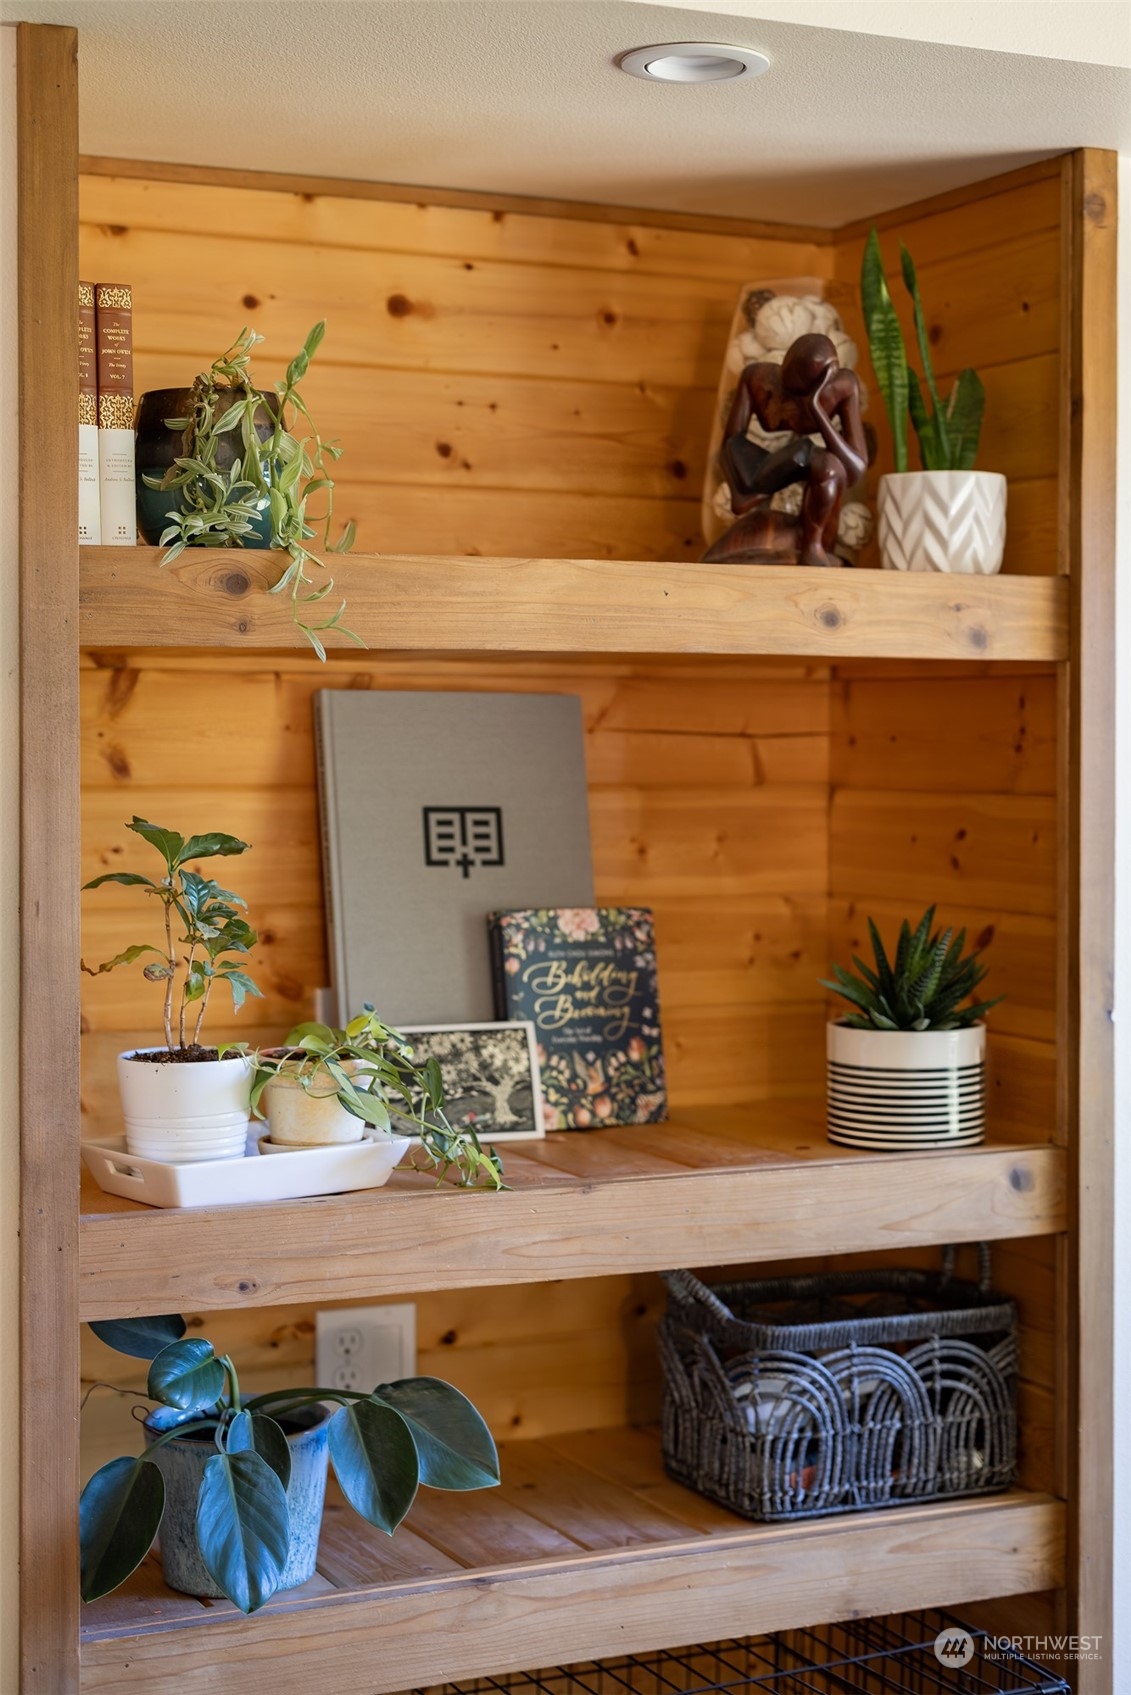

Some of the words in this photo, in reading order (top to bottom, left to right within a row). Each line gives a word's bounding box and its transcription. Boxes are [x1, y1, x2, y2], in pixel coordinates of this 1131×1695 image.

[522, 960, 642, 1006] Beholding
[574, 986, 600, 1004] and
[534, 994, 640, 1041] Becoming
